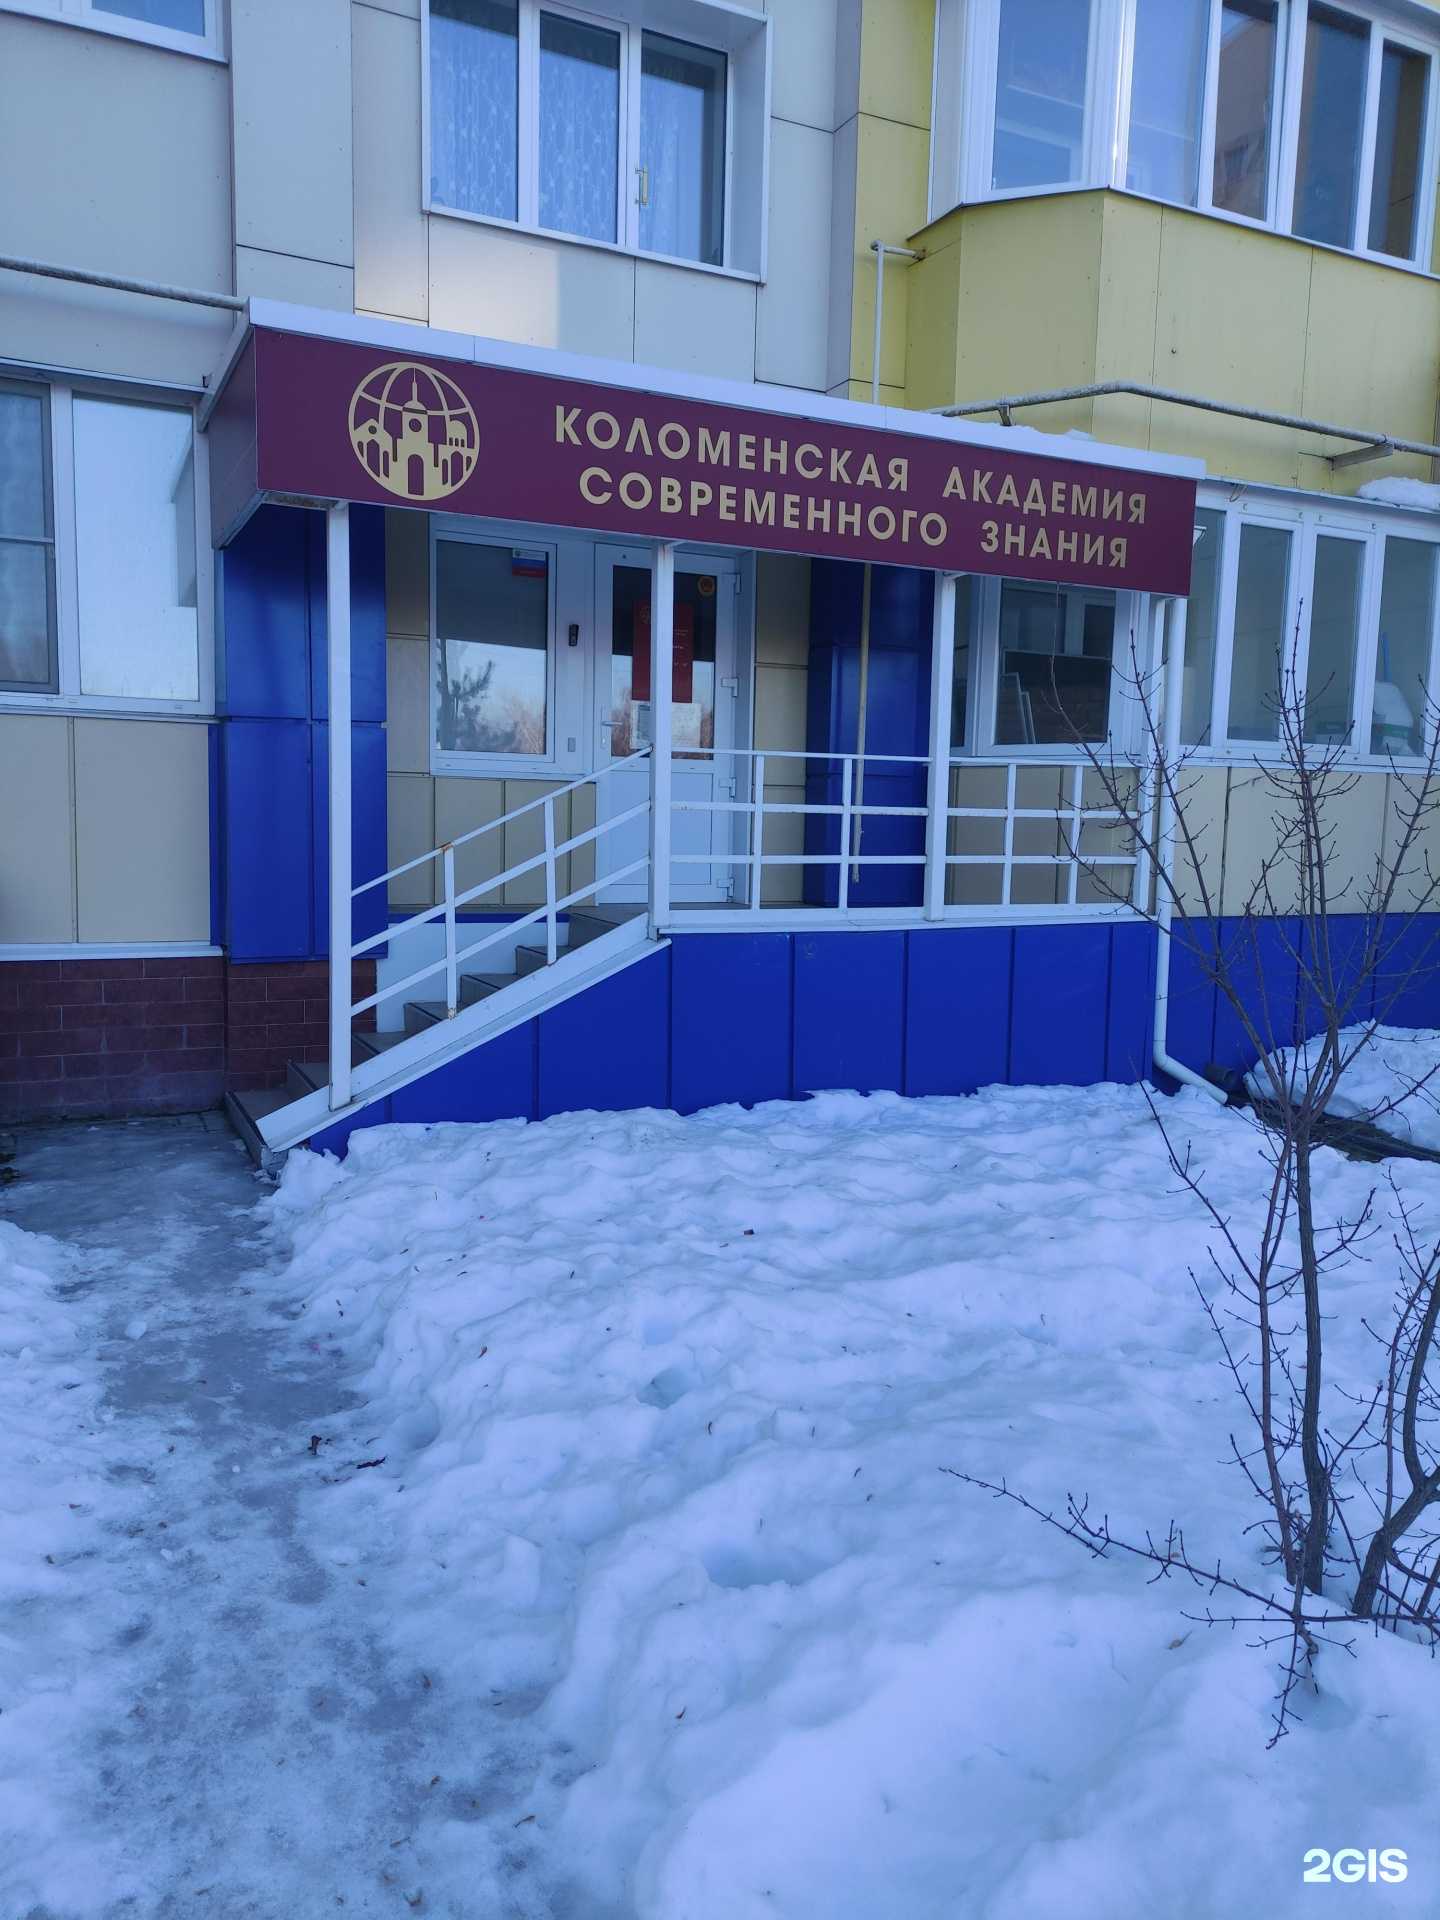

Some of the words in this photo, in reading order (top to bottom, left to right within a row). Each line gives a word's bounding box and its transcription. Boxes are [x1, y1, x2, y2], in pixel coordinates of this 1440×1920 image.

[555, 405, 908, 492] КОЛОМЕНСКАЯ
[942, 466, 1147, 525] АКАДЕМИЯ
[579, 466, 949, 546] СОВРЕМЕННОГО
[981, 520, 1128, 569] ЗНАНИЯ
